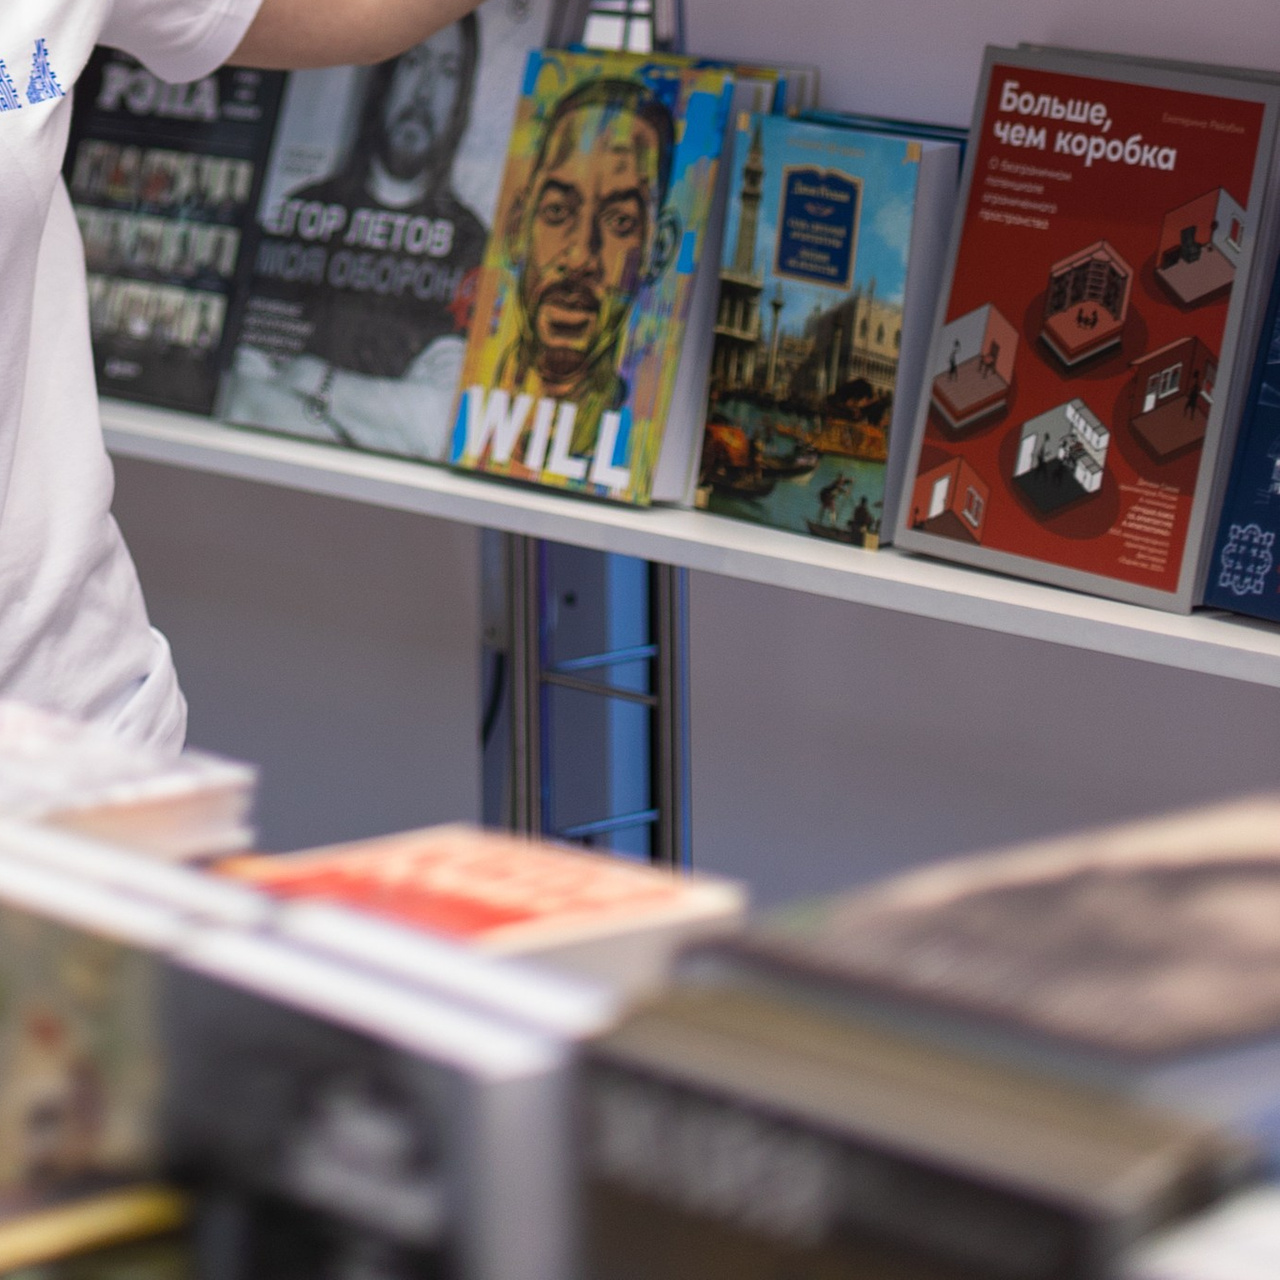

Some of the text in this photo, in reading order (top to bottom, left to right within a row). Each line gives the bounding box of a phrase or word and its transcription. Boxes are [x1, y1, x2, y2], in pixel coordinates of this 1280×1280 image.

[999, 80, 1113, 133] Больше,
[993, 120, 1177, 171] чем коробка
[343, 207, 456, 258] ЛЕТОВ
[255, 242, 326, 281] МОЯ
[465, 386, 631, 492] WILL
